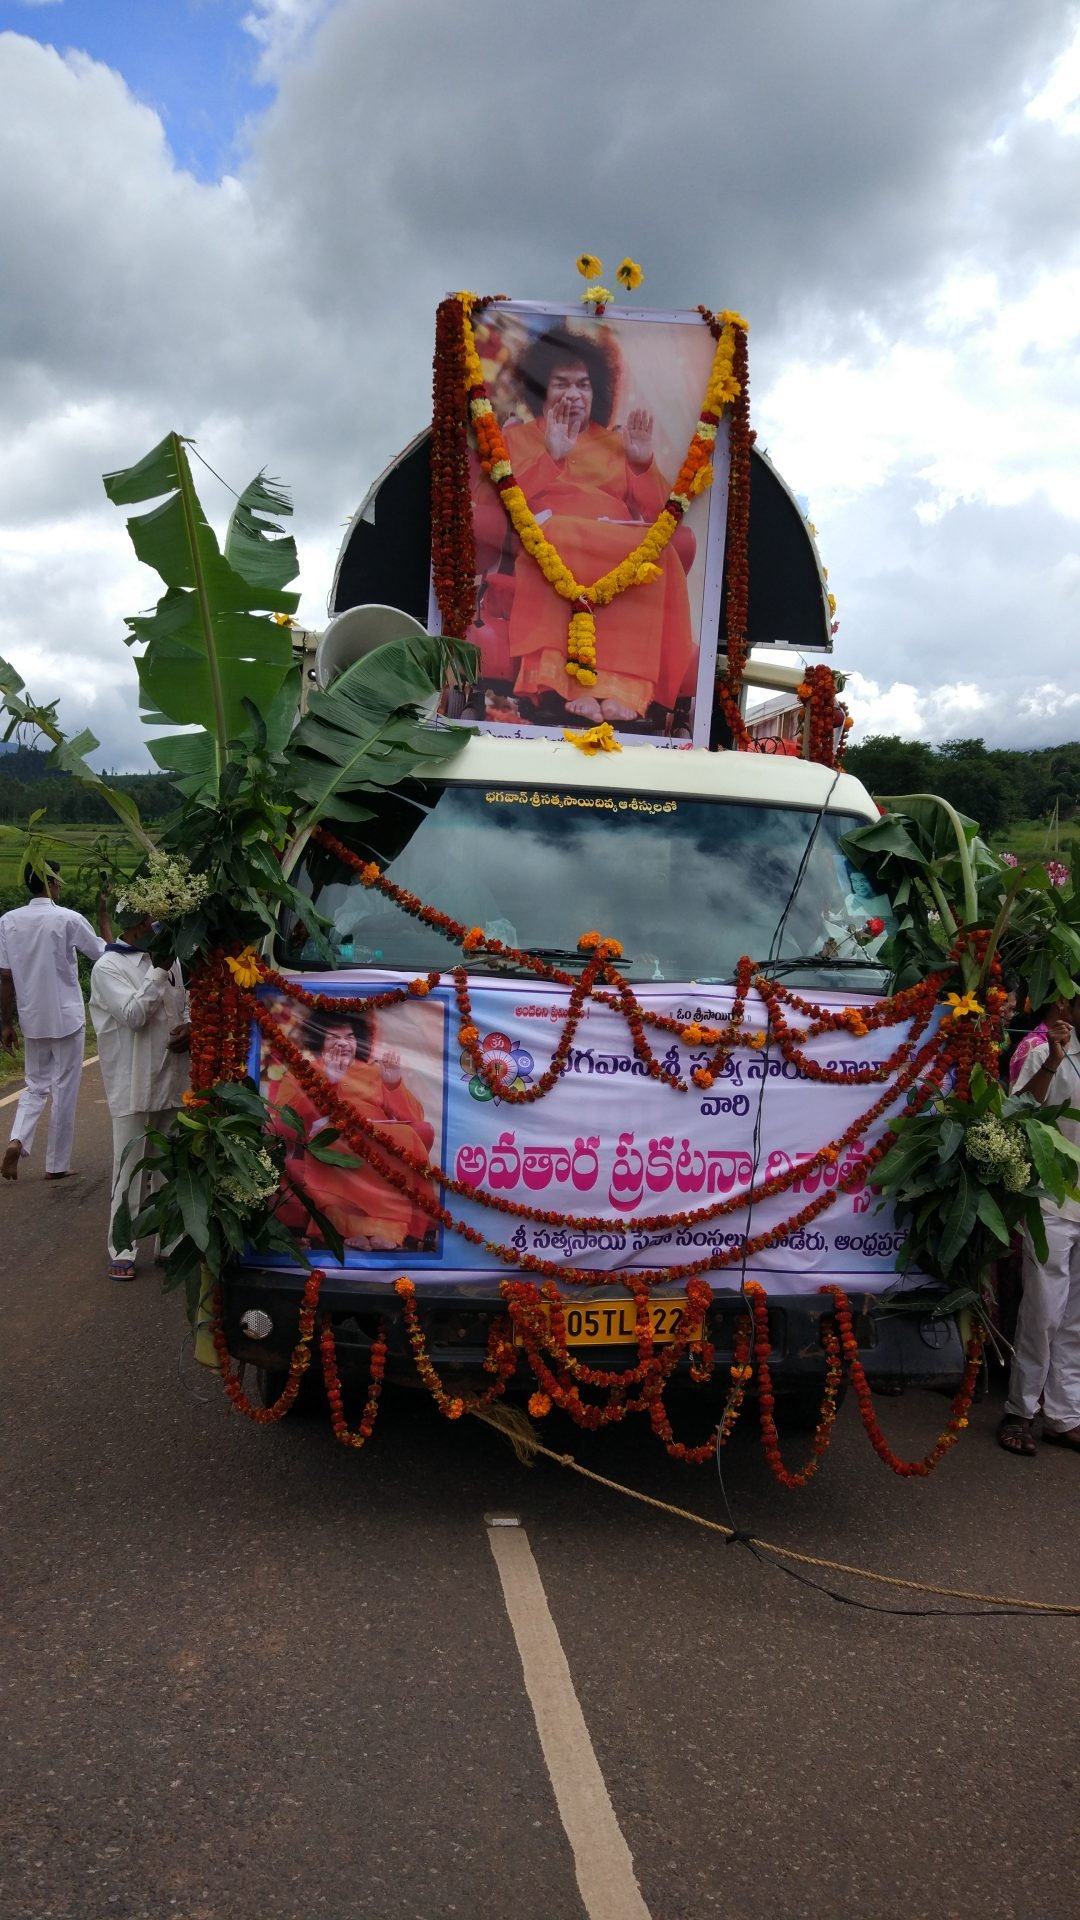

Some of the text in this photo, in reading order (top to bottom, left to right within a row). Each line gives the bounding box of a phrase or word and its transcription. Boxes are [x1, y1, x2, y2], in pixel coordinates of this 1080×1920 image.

[699, 1094, 750, 1117] వారి
[455, 1130, 601, 1193] అవతార
[607, 1131, 753, 1213] ప్రకటనా
[511, 1224, 529, 1253] శ్రీ
[532, 1229, 627, 1258] సత్యసాయి
